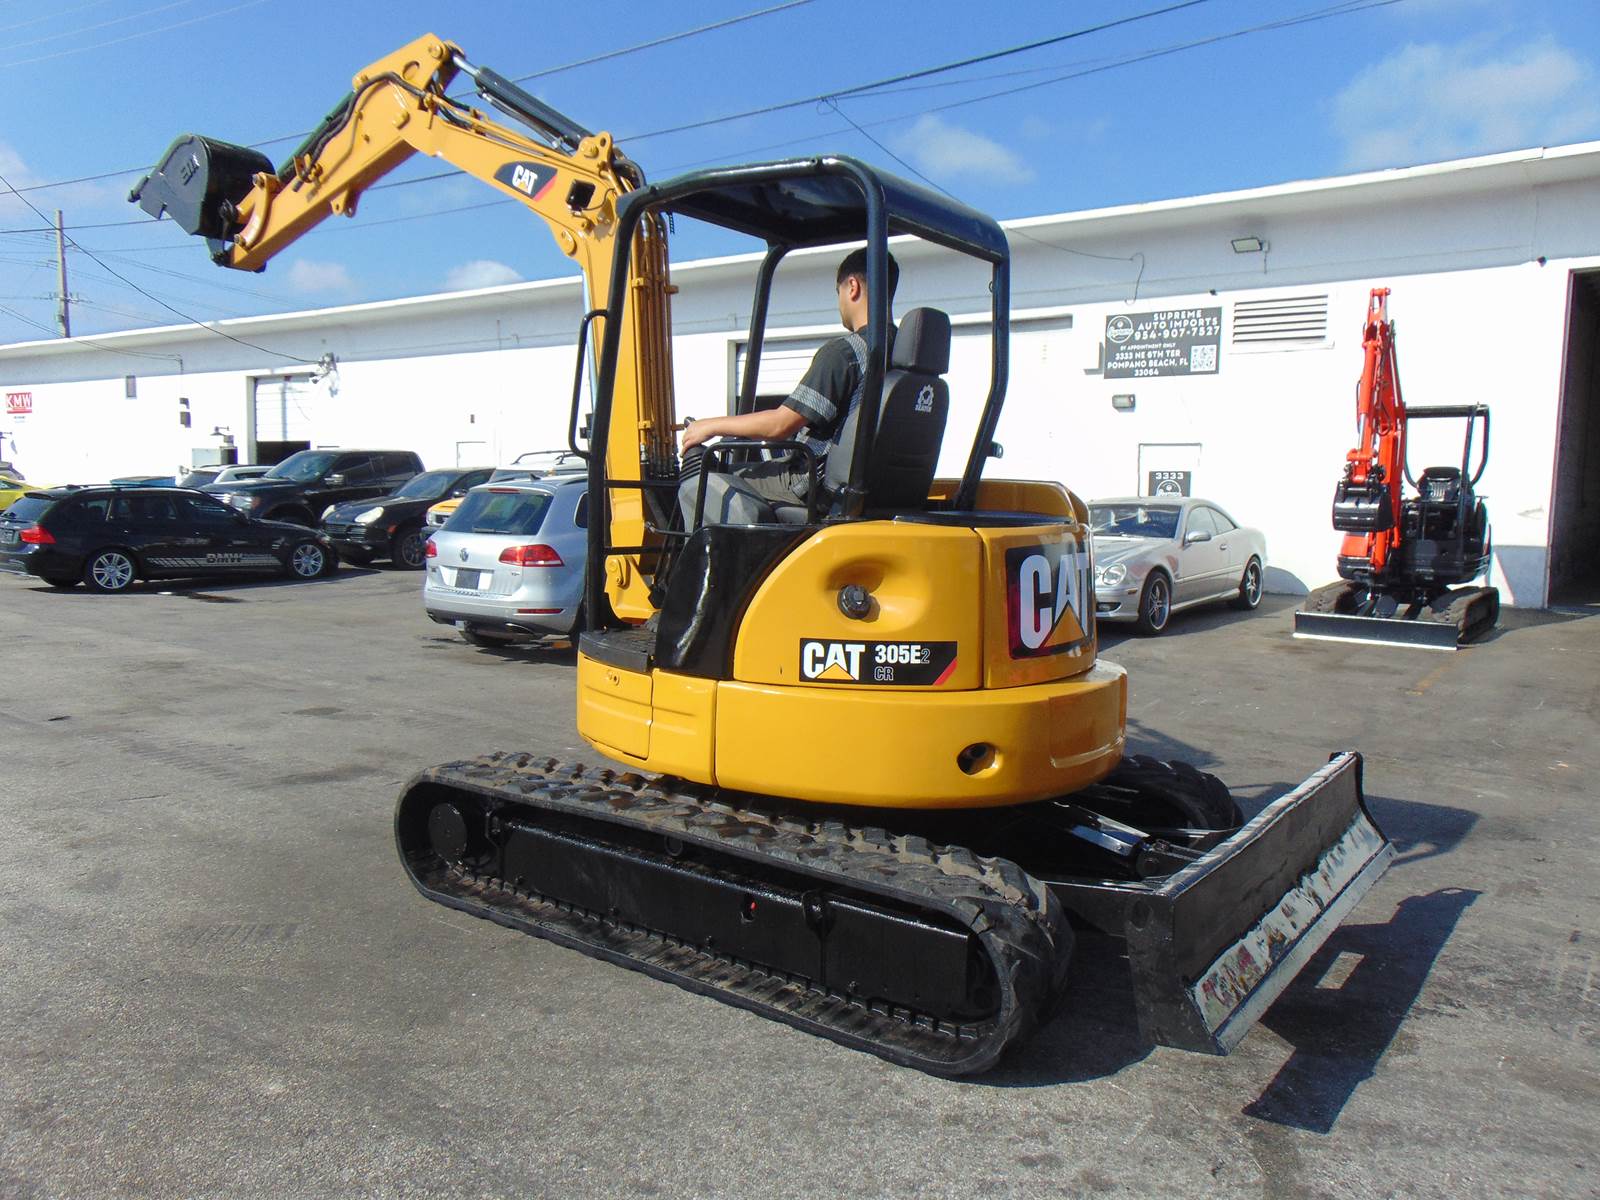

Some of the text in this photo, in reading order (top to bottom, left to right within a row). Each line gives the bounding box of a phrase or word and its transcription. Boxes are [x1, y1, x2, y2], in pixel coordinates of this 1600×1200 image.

[512, 165, 538, 195] CAT
[1154, 310, 1202, 321] SUPREME
[1137, 317, 1217, 331] AUTO IMPORTS
[1134, 326, 1220, 340] 954-907-7527
[1115, 349, 1181, 360] 3333 NE 6TH TER
[1107, 358, 1189, 369] POMPANO BEACH, FL
[1134, 368, 1159, 376] 33064
[6, 393, 32, 409] KMW
[1155, 472, 1184, 480] 3333
[206, 553, 241, 563] BMW
[1019, 552, 1090, 650] CAT
[803, 641, 931, 681] CAT 305E2
[874, 665, 894, 681] CR
